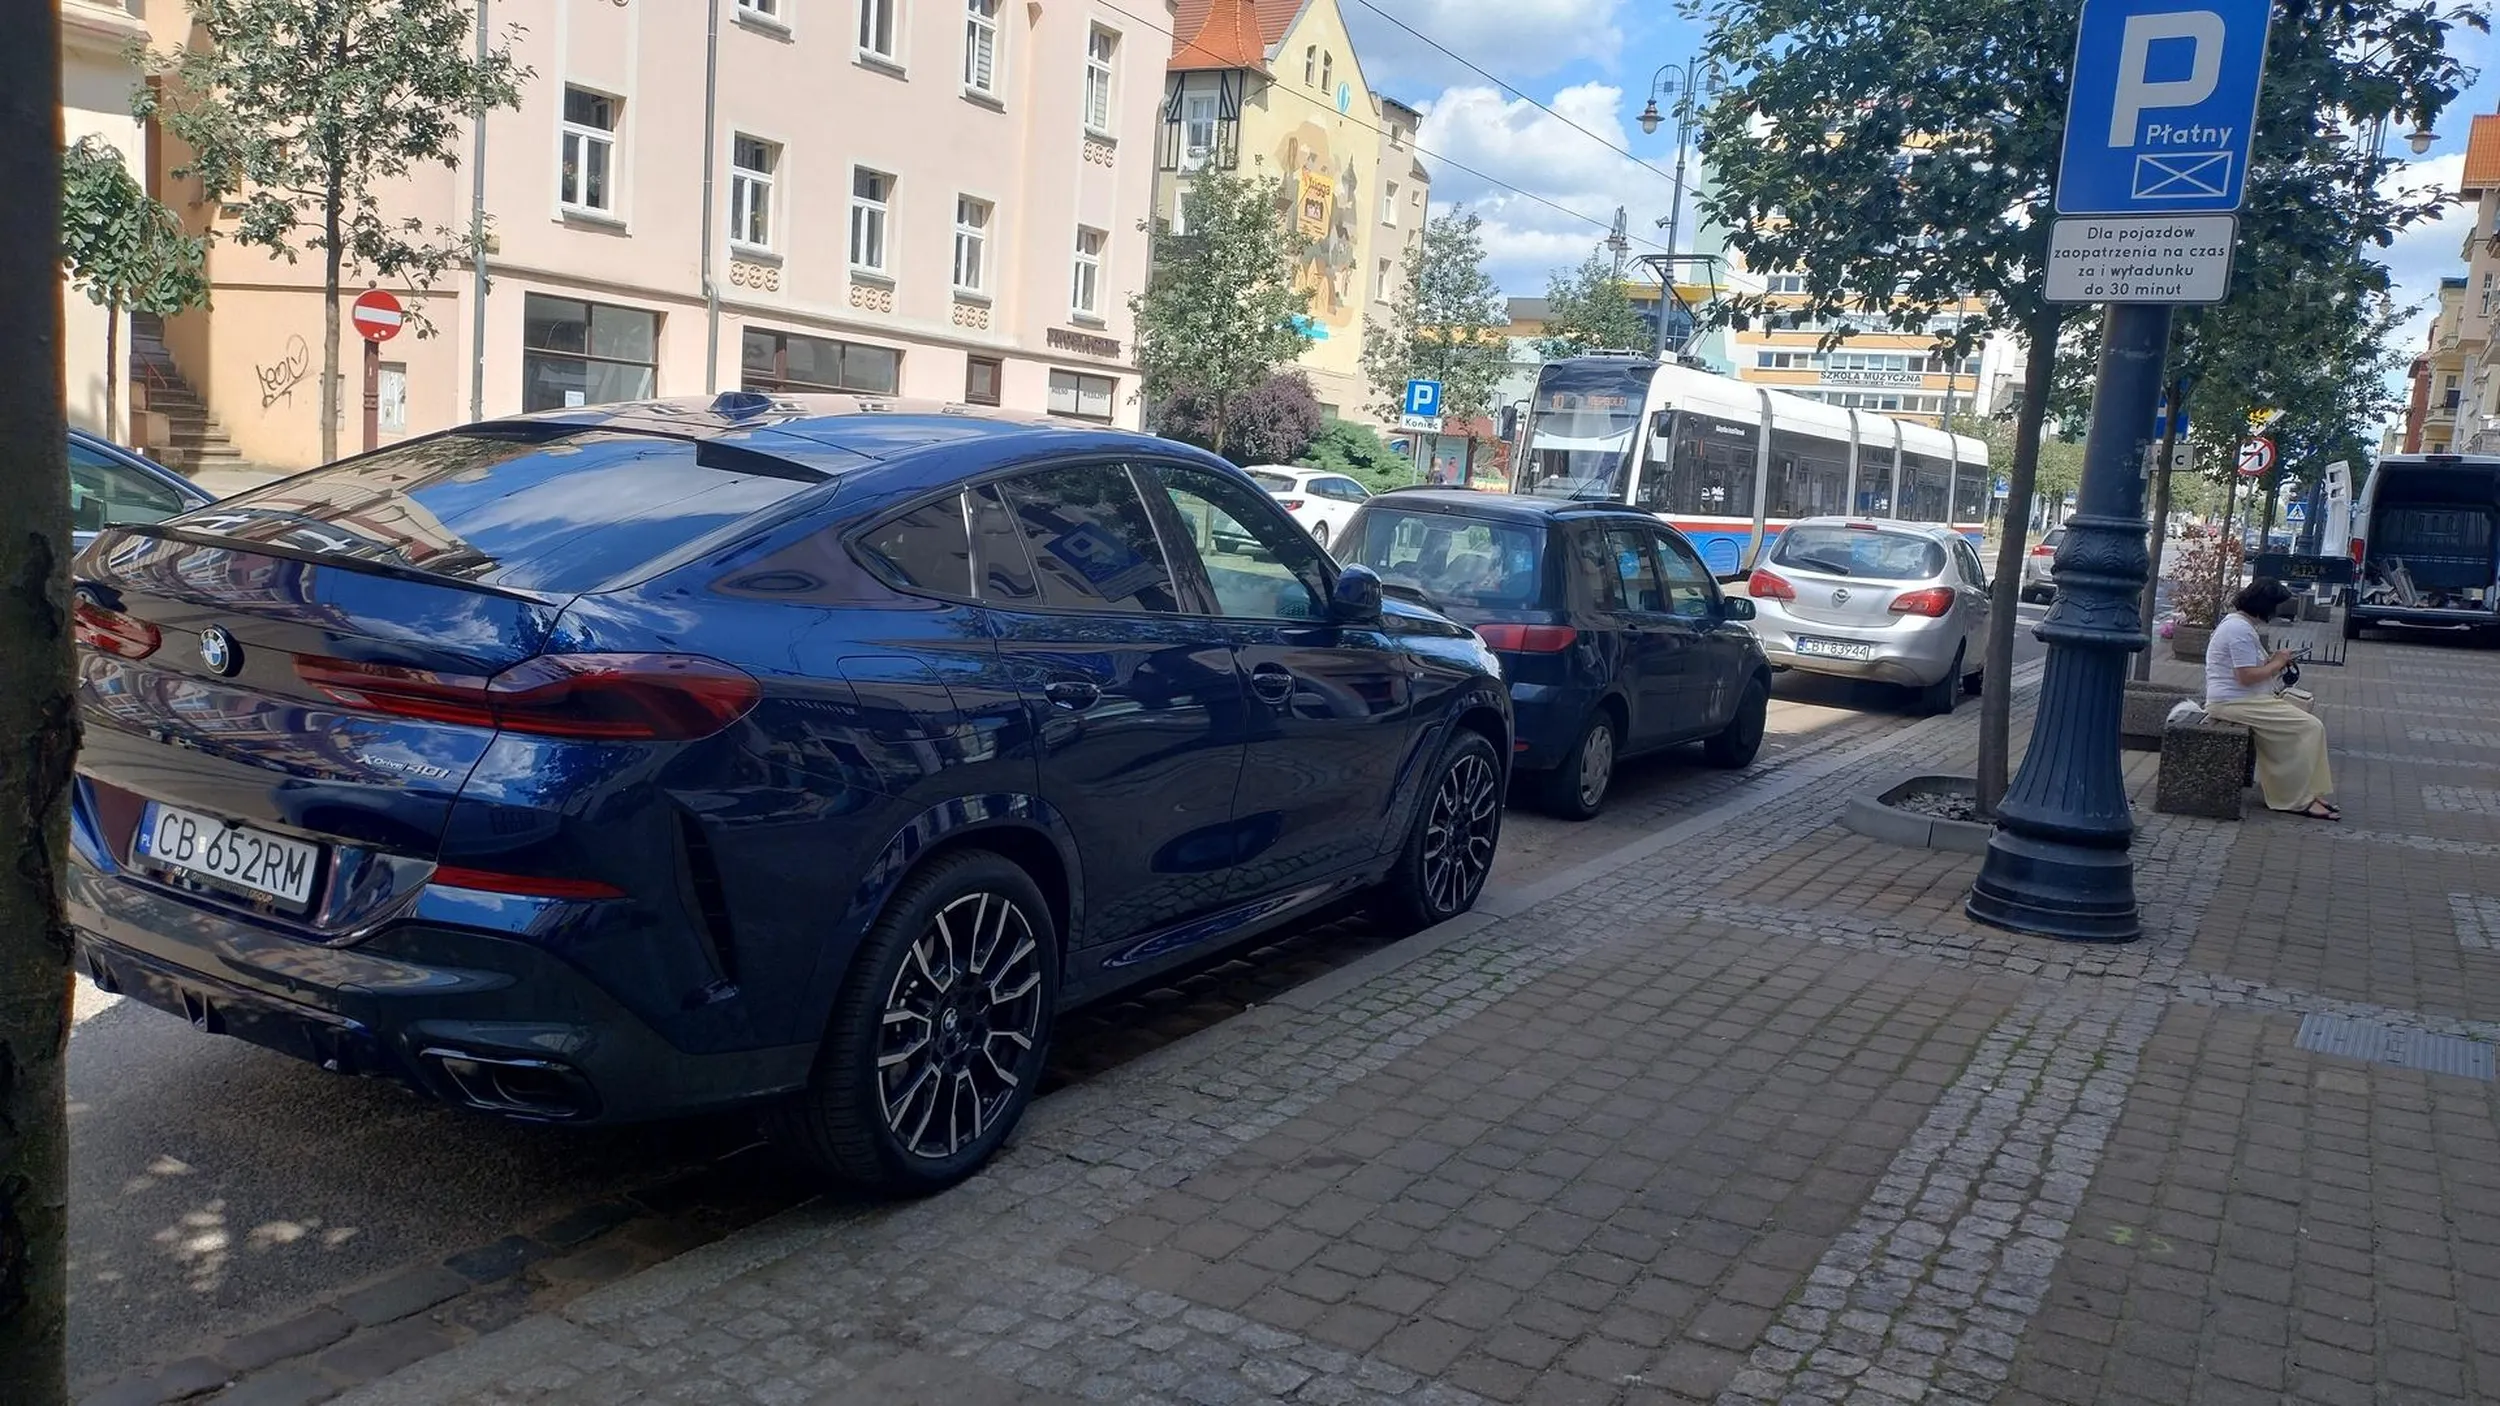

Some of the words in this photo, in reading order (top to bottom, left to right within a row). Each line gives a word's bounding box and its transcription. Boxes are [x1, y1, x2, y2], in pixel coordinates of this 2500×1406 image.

[2108, 10, 2226, 148] P
[2146, 123, 2233, 149] Płatny
[2087, 227, 2113, 240] Dla
[2119, 225, 2196, 242] pojazdów
[2054, 245, 2157, 261] zaopatrzenia
[2163, 247, 2183, 257] na
[2189, 247, 2225, 257] czas
[2078, 267, 2095, 277] za
[2100, 264, 2105, 277] i
[2111, 264, 2194, 280] wyładunku
[2084, 283, 2104, 295] do
[2109, 283, 2129, 295] 30
[2135, 283, 2182, 295] minut
[1864, 372, 1921, 383] MUZYCZNA
[1412, 384, 1434, 412] P
[1405, 417, 1438, 430] Koniec
[158, 813, 197, 862] CB
[206, 828, 307, 896] 652RM
